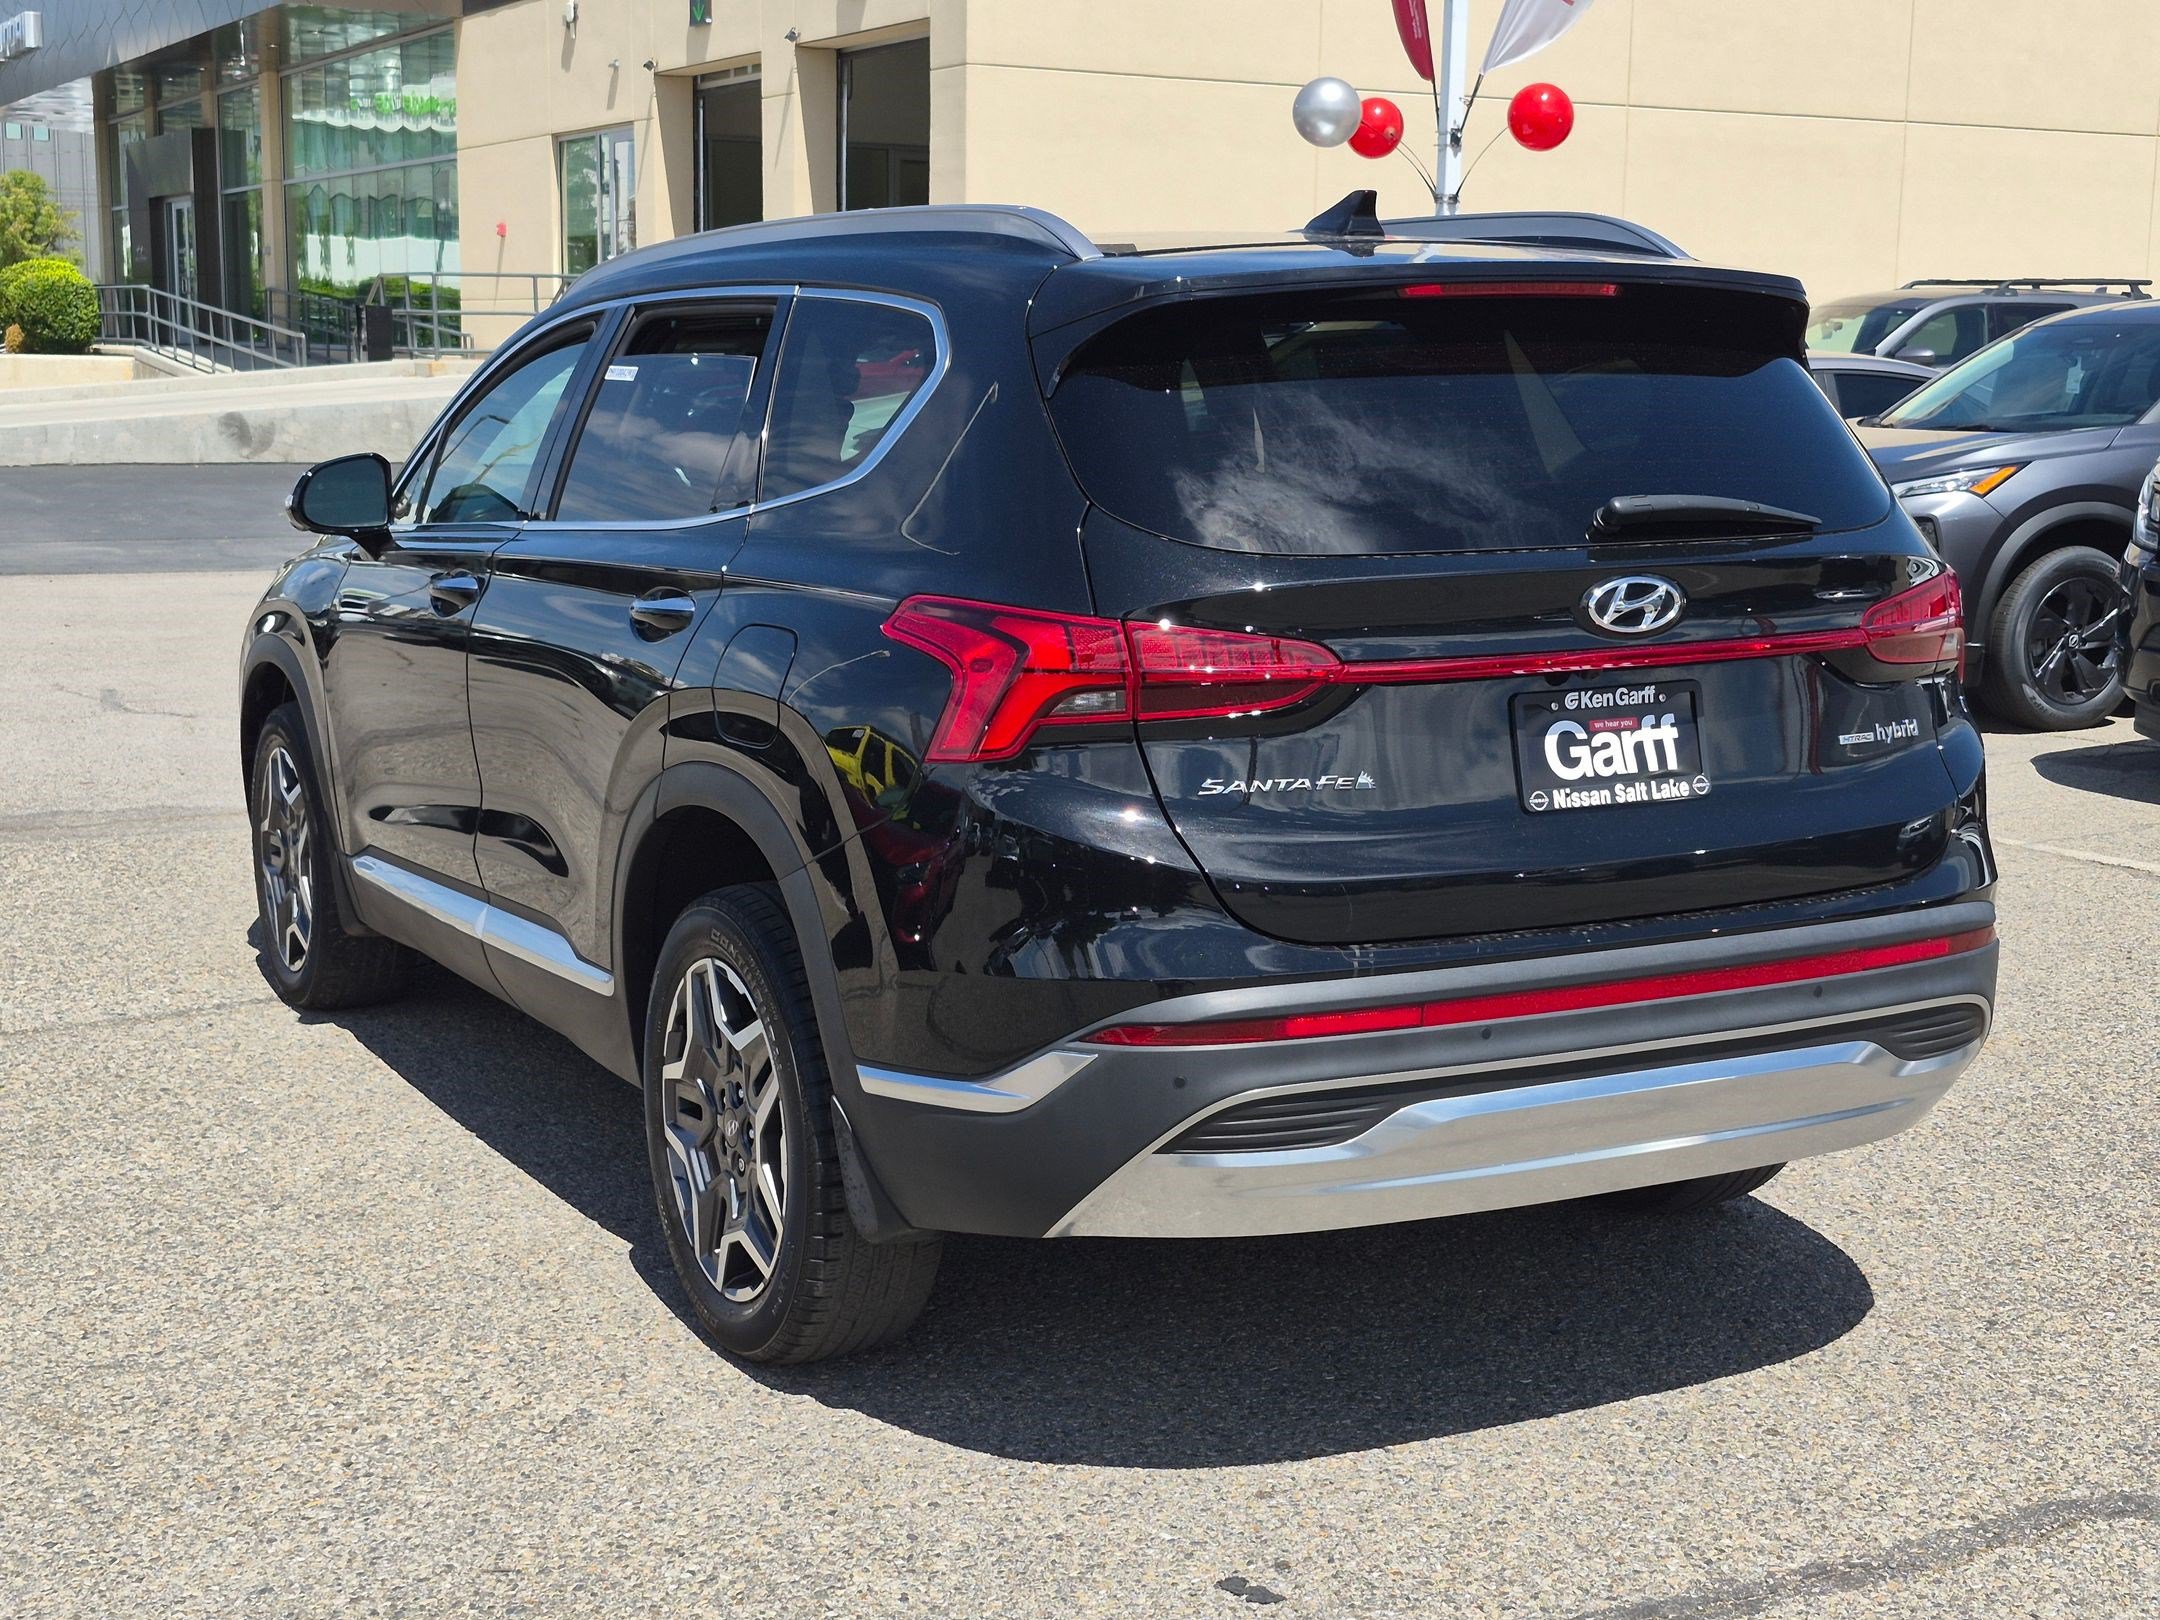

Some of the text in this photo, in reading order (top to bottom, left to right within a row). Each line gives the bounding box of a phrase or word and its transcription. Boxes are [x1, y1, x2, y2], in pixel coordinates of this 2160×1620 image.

[1580, 685, 1656, 709] Ken Garff
[1604, 720, 1620, 728] hear
[1620, 719, 1633, 729] you
[1875, 719, 1919, 744] hybrid
[1544, 713, 1679, 781] Garff
[1197, 774, 1355, 797] SANTA FE
[1552, 777, 1690, 809] Nissan Salt Lake
